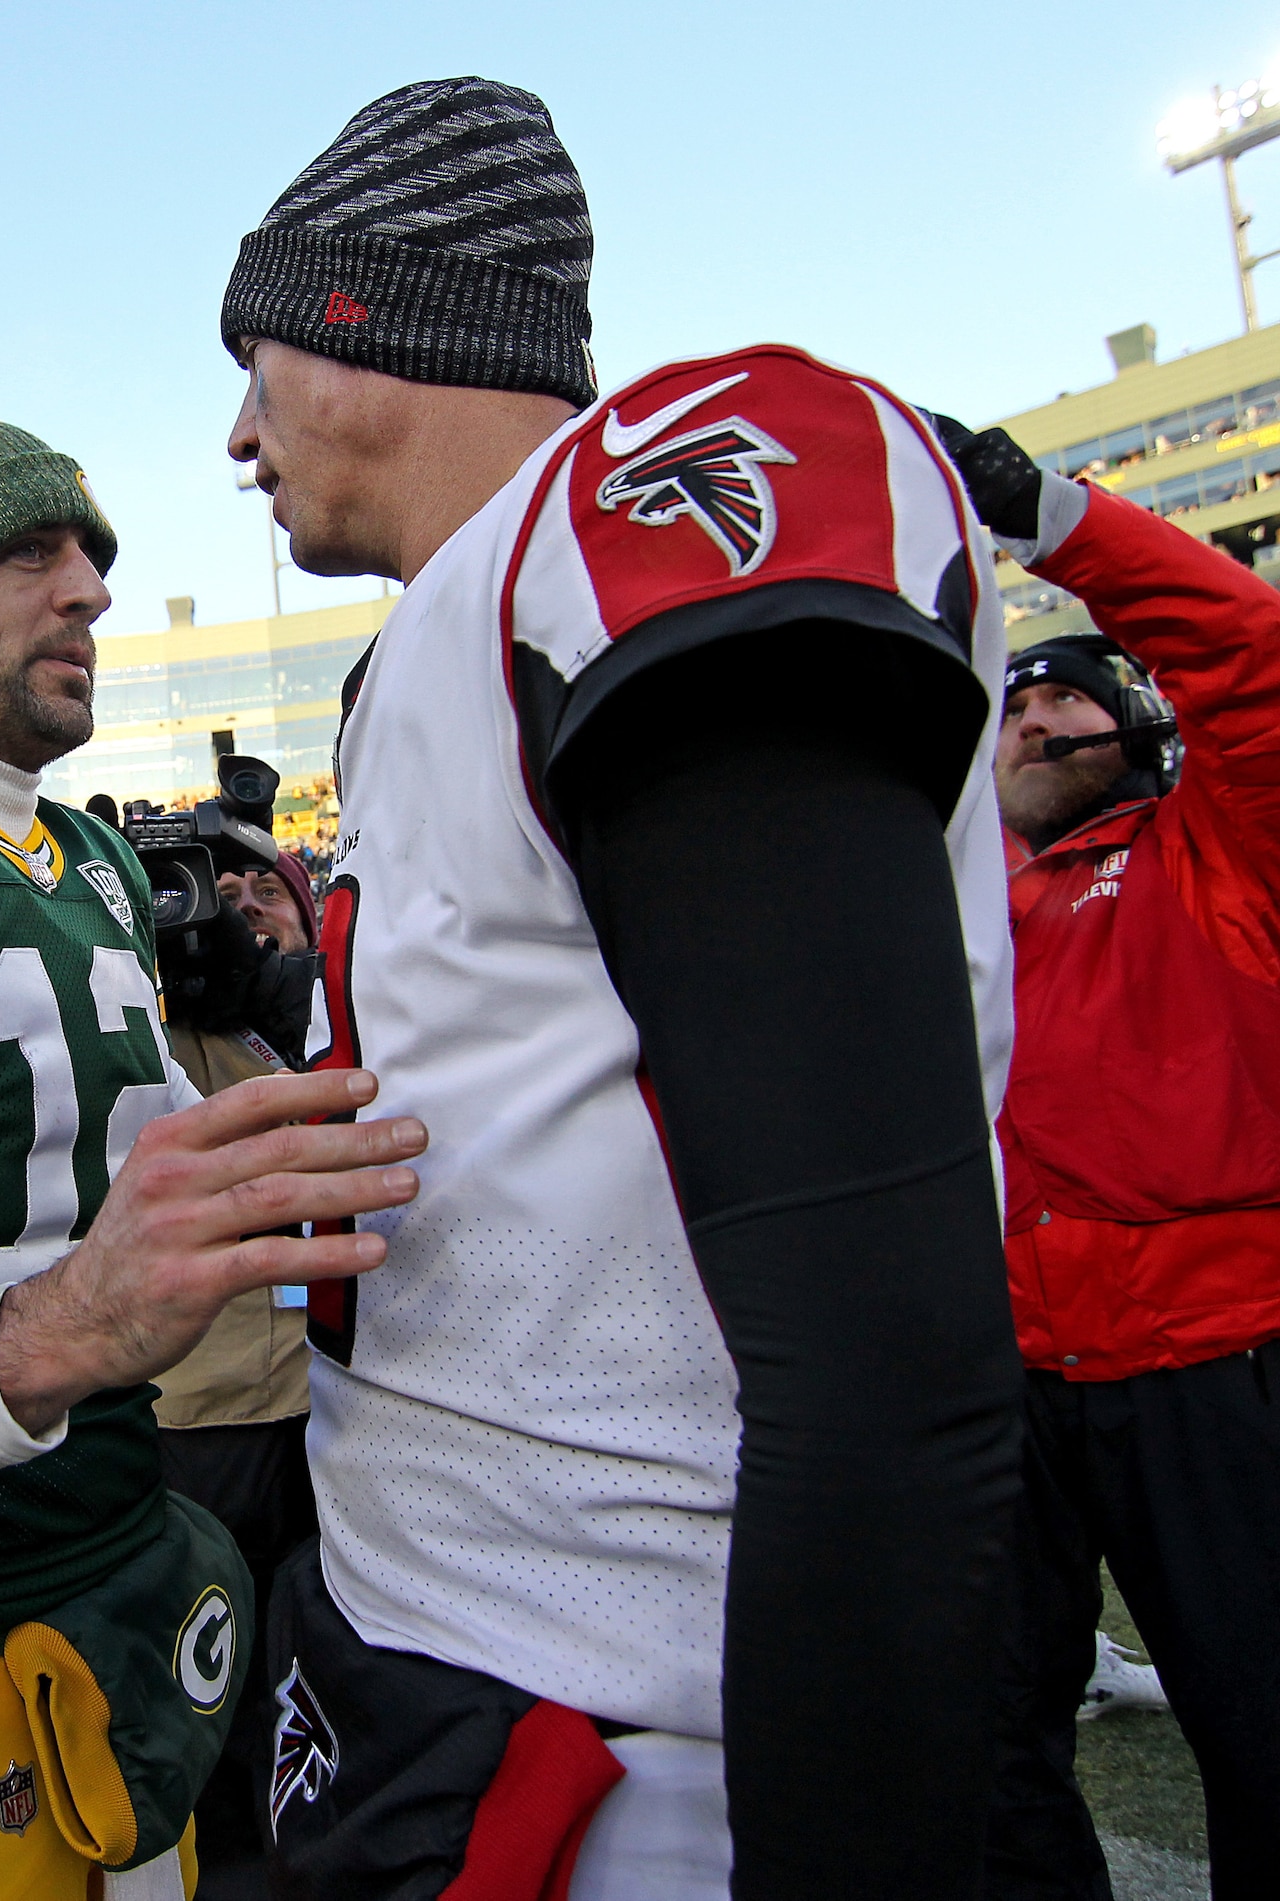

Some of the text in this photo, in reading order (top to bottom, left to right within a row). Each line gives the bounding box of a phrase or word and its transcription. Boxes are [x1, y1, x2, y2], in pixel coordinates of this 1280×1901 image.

[1070, 880, 1121, 914] TELEVI
[248, 1037, 277, 1063] RISE
[177, 1592, 234, 1707] G
[2, 1790, 34, 1825] NFL
